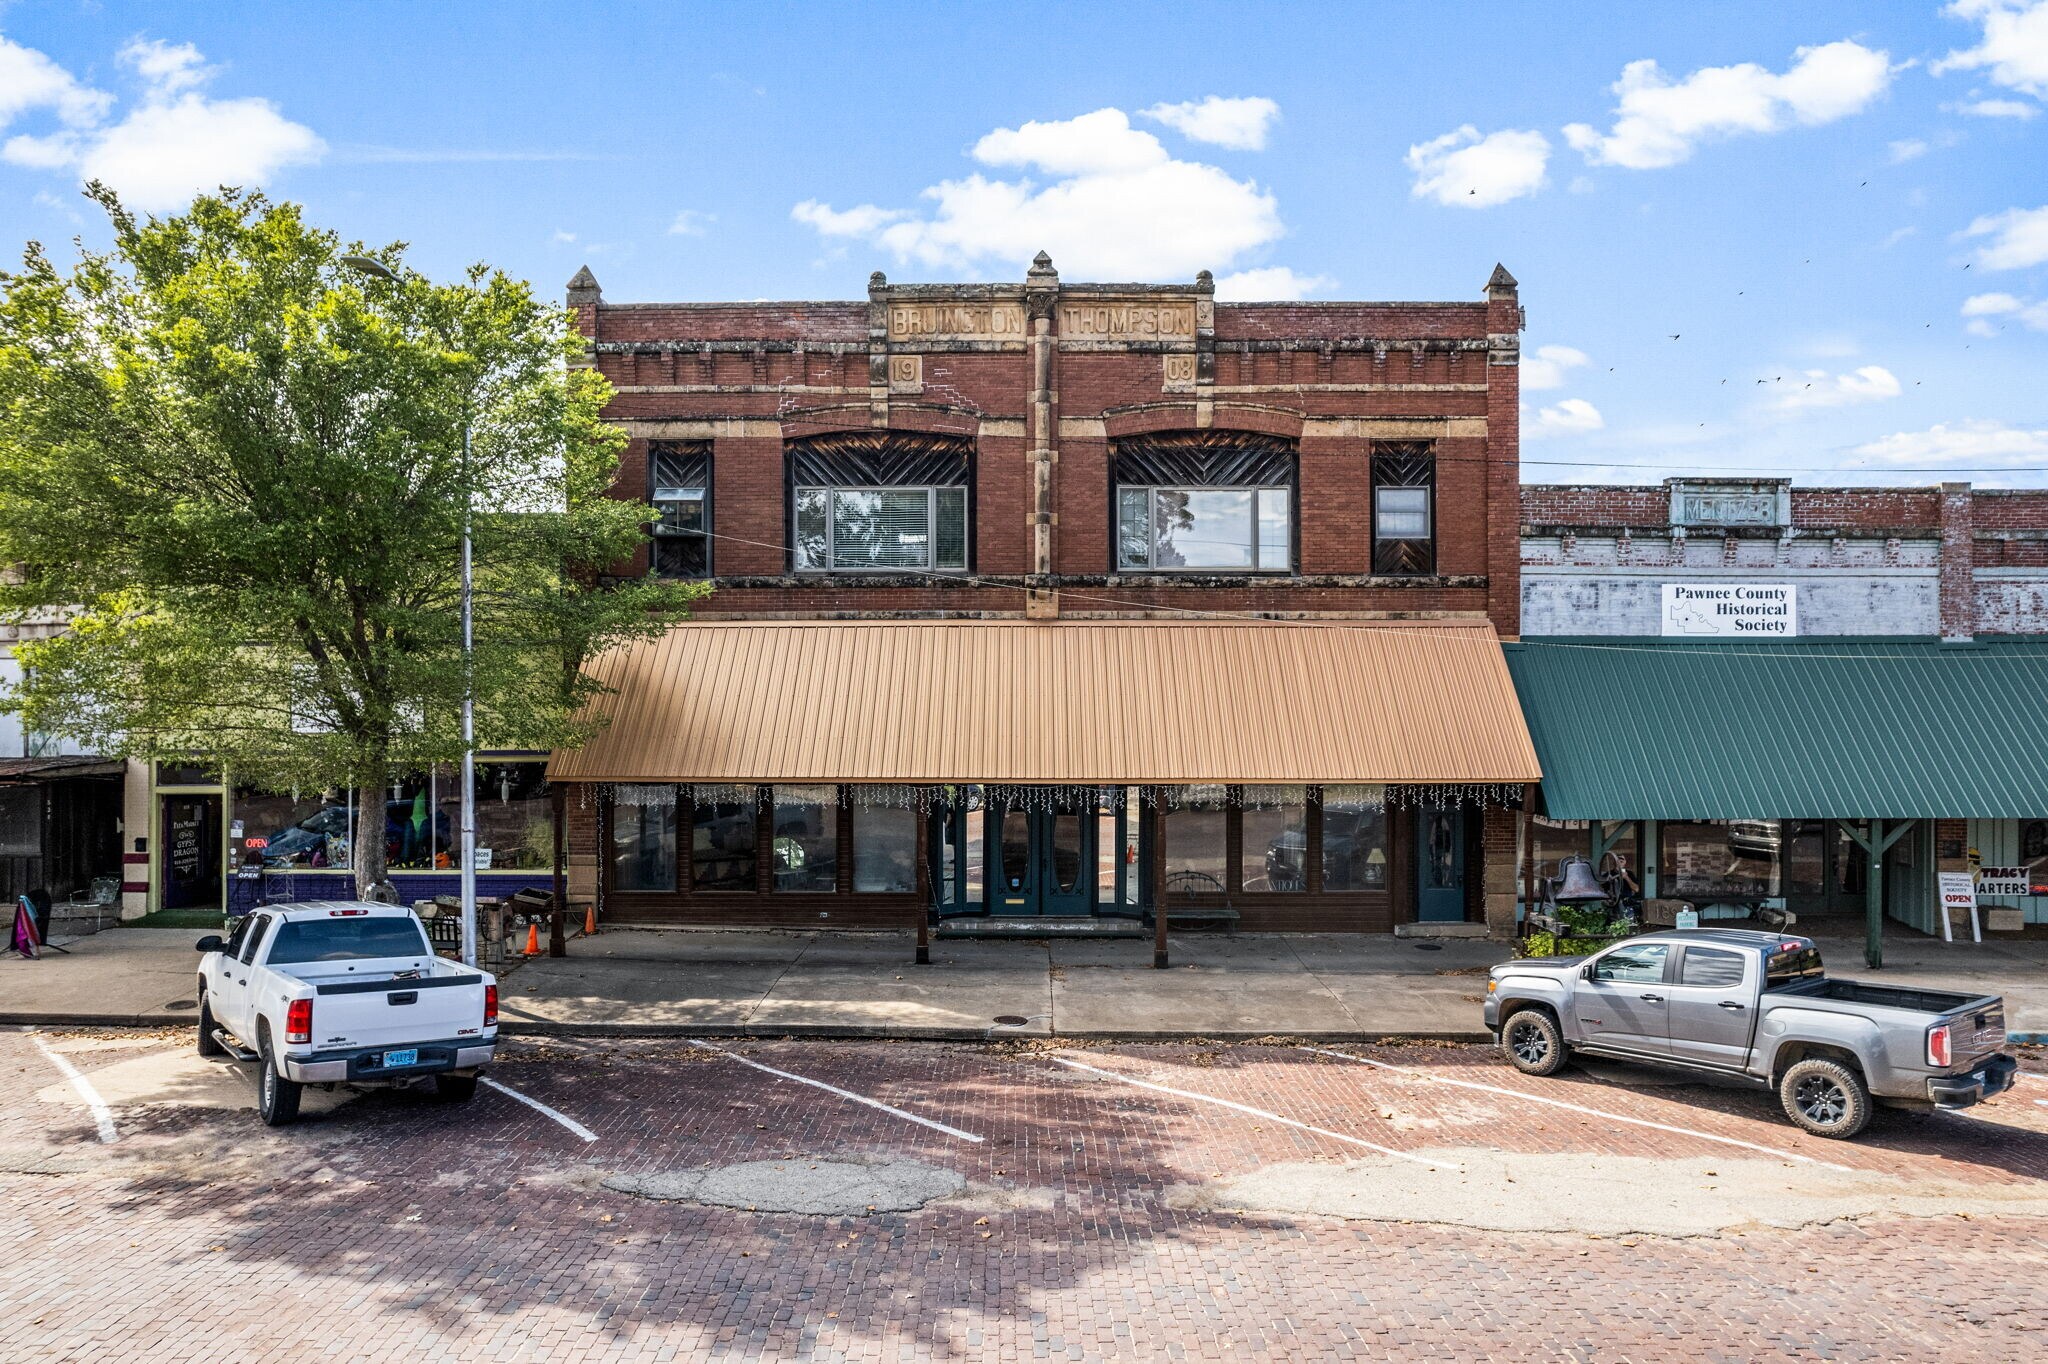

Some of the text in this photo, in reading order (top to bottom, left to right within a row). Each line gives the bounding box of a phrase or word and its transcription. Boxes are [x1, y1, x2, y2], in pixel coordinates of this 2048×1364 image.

[892, 306, 1022, 336] BRUINGTON
[1063, 306, 1192, 336] THOMPSON
[892, 359, 917, 382] 19
[1167, 358, 1193, 381] 08
[1685, 498, 1771, 521] MENTZER
[1675, 587, 1787, 602] Pawnee County
[1716, 603, 1787, 615] Historical
[1734, 618, 1787, 633] Society
[176, 840, 196, 848] GYPSY
[246, 838, 268, 848] OPEN
[174, 847, 198, 857] DRAGON
[1981, 867, 2028, 878] TRACY
[1974, 883, 2027, 894] ARTERS
[1945, 894, 1972, 903] OPEN
